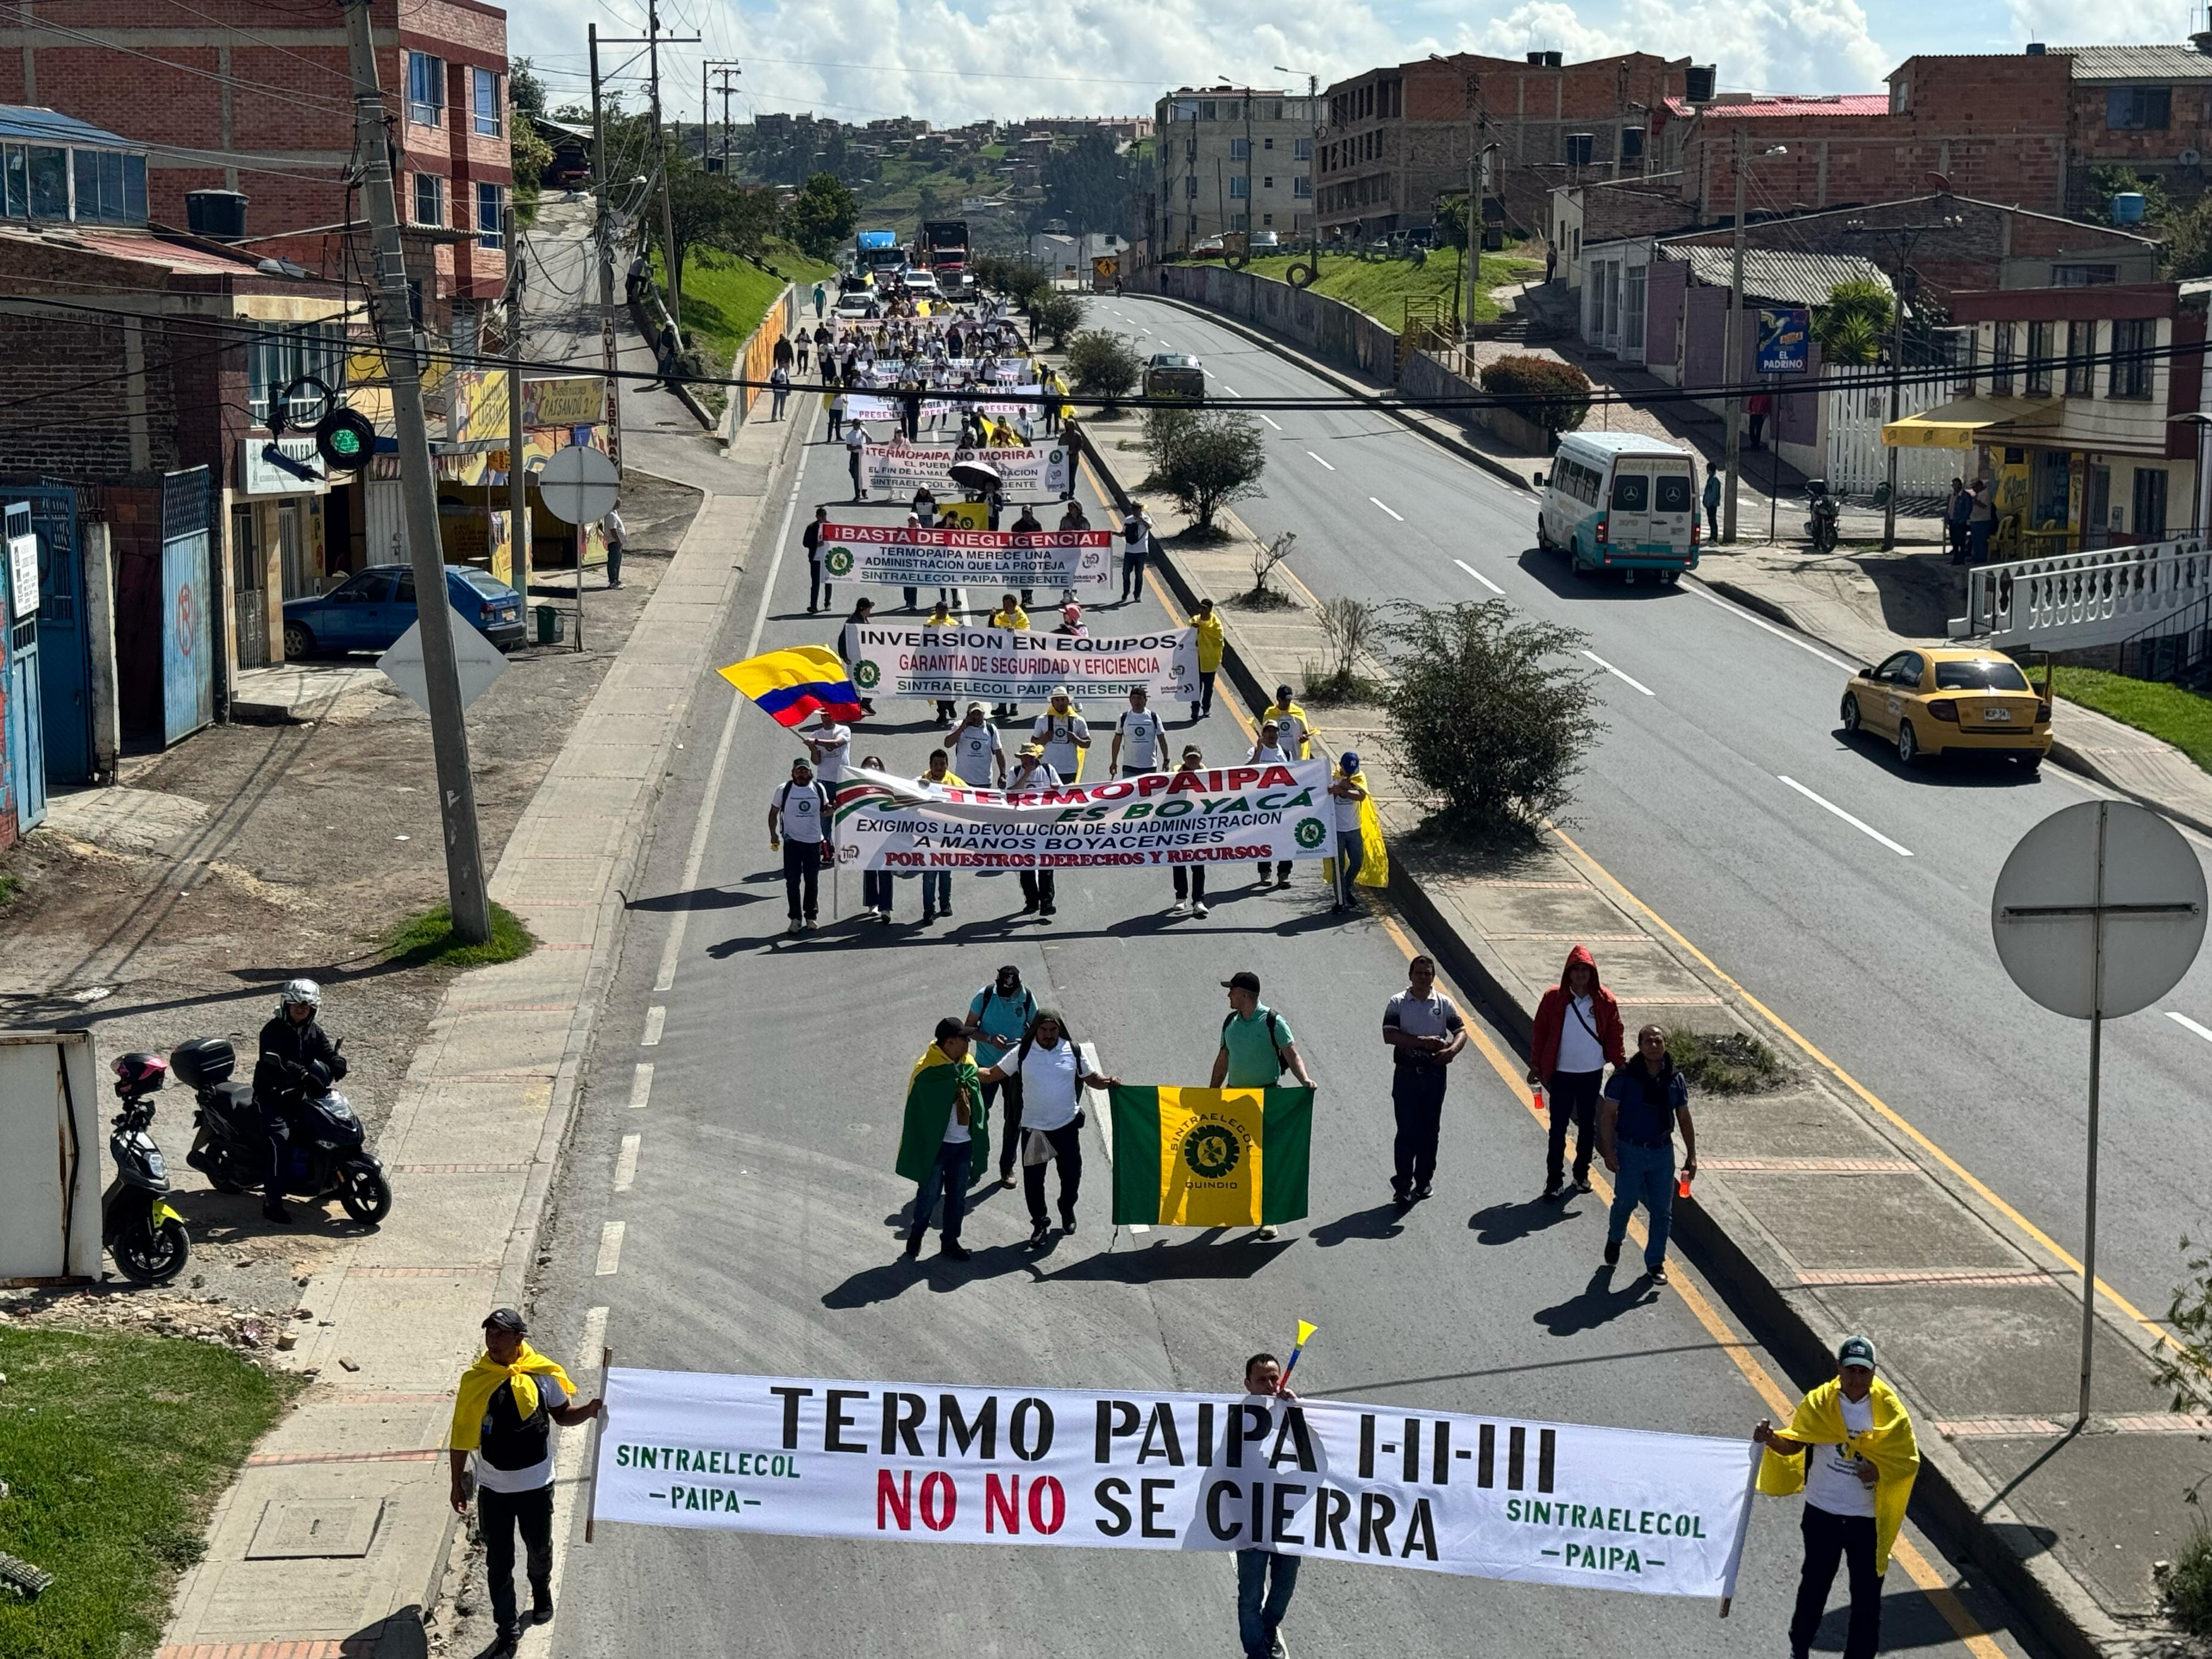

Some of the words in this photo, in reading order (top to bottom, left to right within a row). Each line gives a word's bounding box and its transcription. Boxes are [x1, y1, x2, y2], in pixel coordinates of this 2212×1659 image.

[605, 338, 615, 387] ULTIA
[1764, 359, 1803, 369] PADRINO
[1779, 351, 1788, 359] EL
[866, 447, 951, 460] ¡TERMOPAIPA
[955, 451, 975, 461] NO
[979, 450, 1036, 461] MORIRA
[834, 527, 910, 543] ¡BASTA
[918, 531, 945, 544] DE
[951, 531, 1099, 546] NEGLIGENCIA!
[880, 547, 963, 560] TERMOPAIPA
[966, 550, 1020, 560] MERECE
[1024, 551, 1052, 560] UNA
[865, 558, 964, 571] ADMINISTRACION
[968, 561, 992, 571] QUE
[995, 562, 1009, 571] LA
[1013, 561, 1065, 571] PROTEJA
[862, 571, 959, 583] SINTRAELECOL
[963, 574, 999, 584] PAIPA
[1002, 574, 1068, 584] PRESENTE
[860, 630, 1003, 650] INVERSION
[1013, 636, 1047, 651] EN
[1056, 635, 1184, 651] EQUIPOS,
[899, 654, 967, 671] GARANTIA
[972, 657, 988, 673] DE
[991, 658, 1069, 675] SEGURIDAD
[1073, 659, 1082, 674] Y
[1085, 657, 1160, 674] EFICIENCIA
[898, 680, 1012, 695] SINTRAELECOL
[941, 765, 1299, 807] TERMOPAIPA
[1056, 806, 1109, 823] ES
[1122, 787, 1317, 820] BOYACÁ
[857, 819, 938, 833] EXIGIMOS
[943, 822, 964, 834] LA
[969, 822, 1077, 836] DEVOLUCION
[1084, 823, 1105, 836] DE
[1111, 821, 1133, 834] SU
[1137, 811, 1283, 834] ADMINISTRACION
[913, 836, 931, 848] A
[940, 837, 1036, 850] MANOS
[1045, 831, 1226, 850] BOYACENSES
[885, 852, 926, 867] POR
[929, 852, 1036, 867] NUESTROS
[1040, 851, 1146, 867] DERECHOS
[1150, 850, 1165, 864] Y
[1167, 844, 1273, 863] RECURSOS
[1171, 1113, 1255, 1152] SINTRAELECOL
[1185, 1181, 1238, 1190] QUINDIO
[770, 1386, 1055, 1462] TERMO
[1095, 1399, 1318, 1472] PAIPA
[1358, 1414, 1556, 1494] I-II-III
[616, 1443, 801, 1479] SINTRAELECOL
[877, 1469, 957, 1532] NO
[986, 1473, 1066, 1536] NO
[1094, 1477, 1176, 1539] SE
[1206, 1479, 1439, 1561] CIERRA
[1506, 1498, 1707, 1540] SINTRAELECOL
